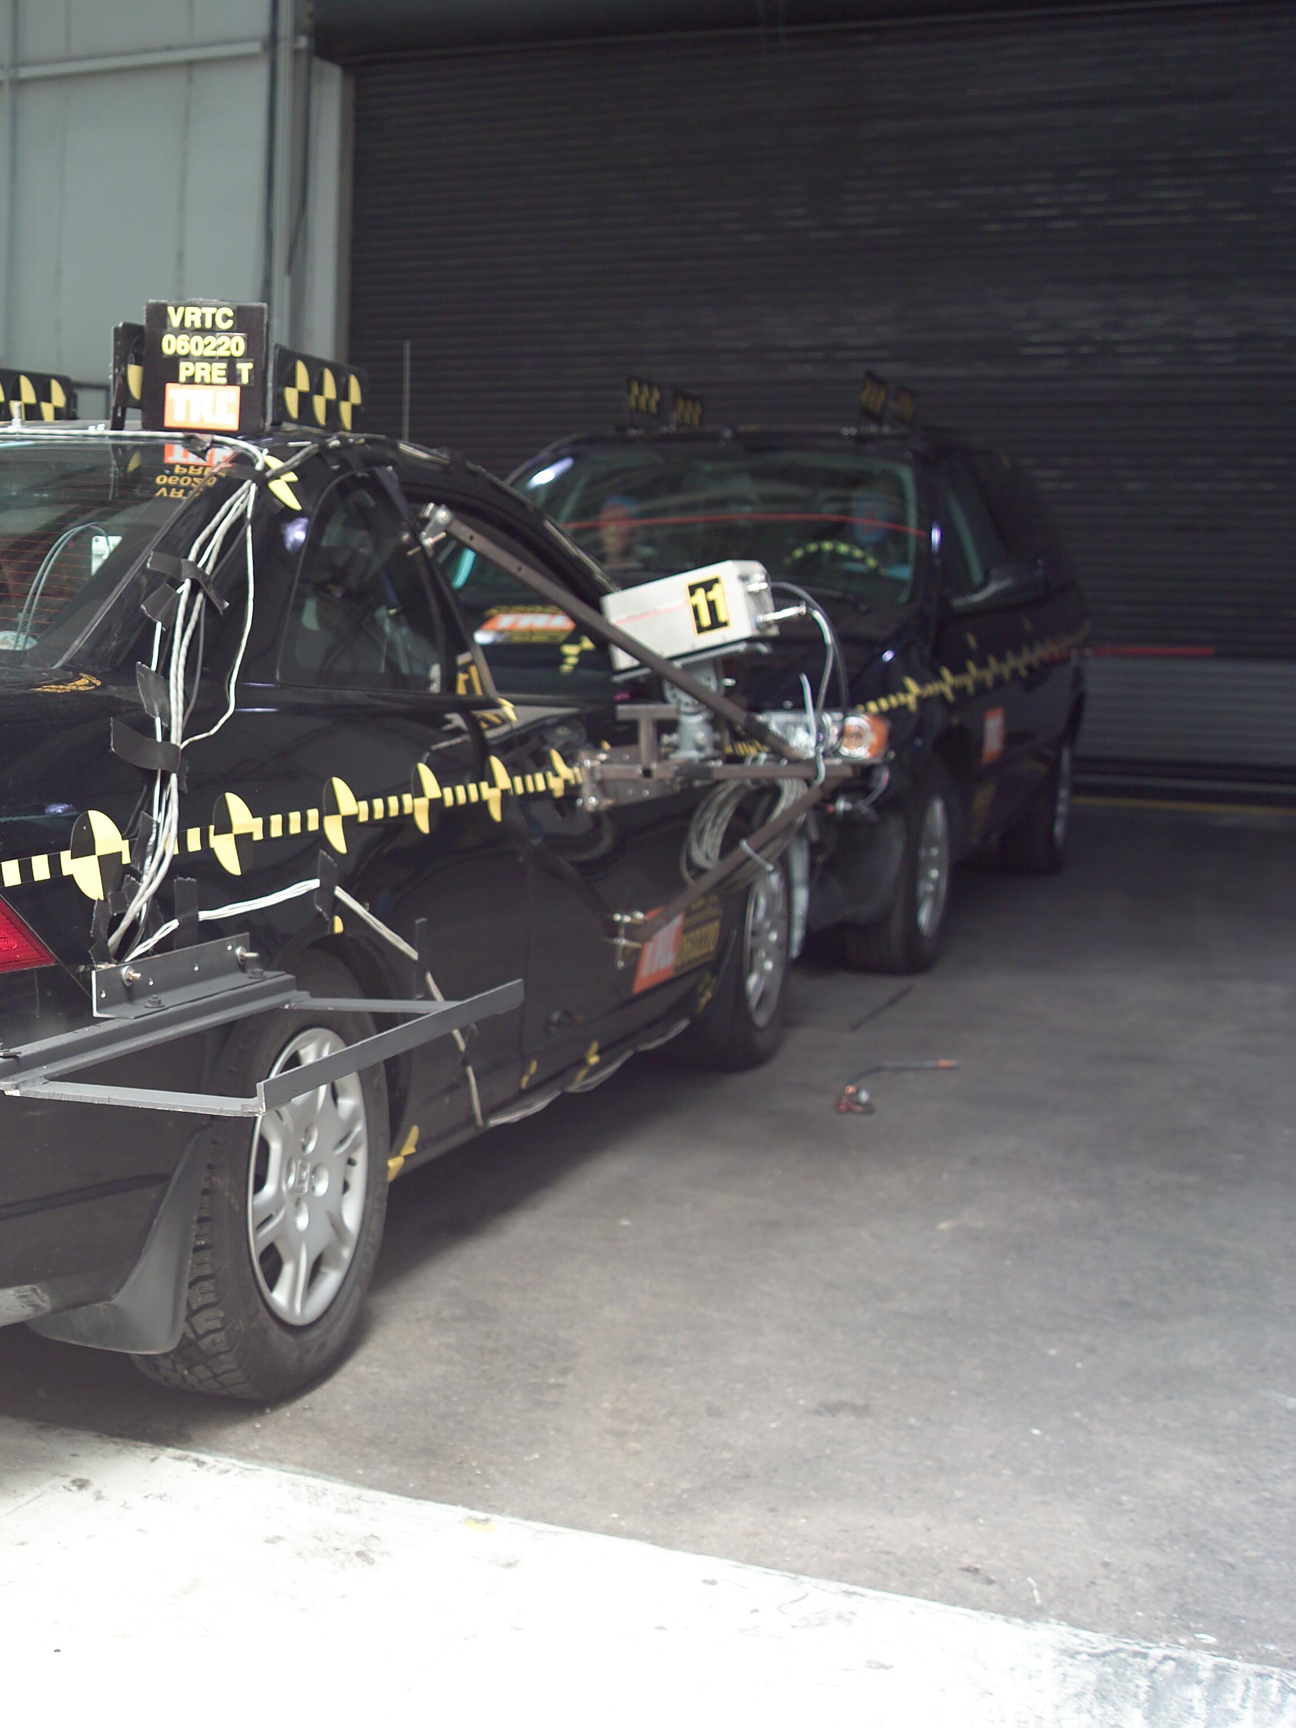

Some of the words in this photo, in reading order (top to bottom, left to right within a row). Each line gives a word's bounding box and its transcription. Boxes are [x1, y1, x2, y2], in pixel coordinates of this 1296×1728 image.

[167, 305, 234, 330] VRTC
[161, 333, 246, 358] 060220
[179, 361, 228, 385] PRE
[236, 362, 254, 385] T
[168, 388, 238, 425] TRC
[690, 582, 730, 628] 11
